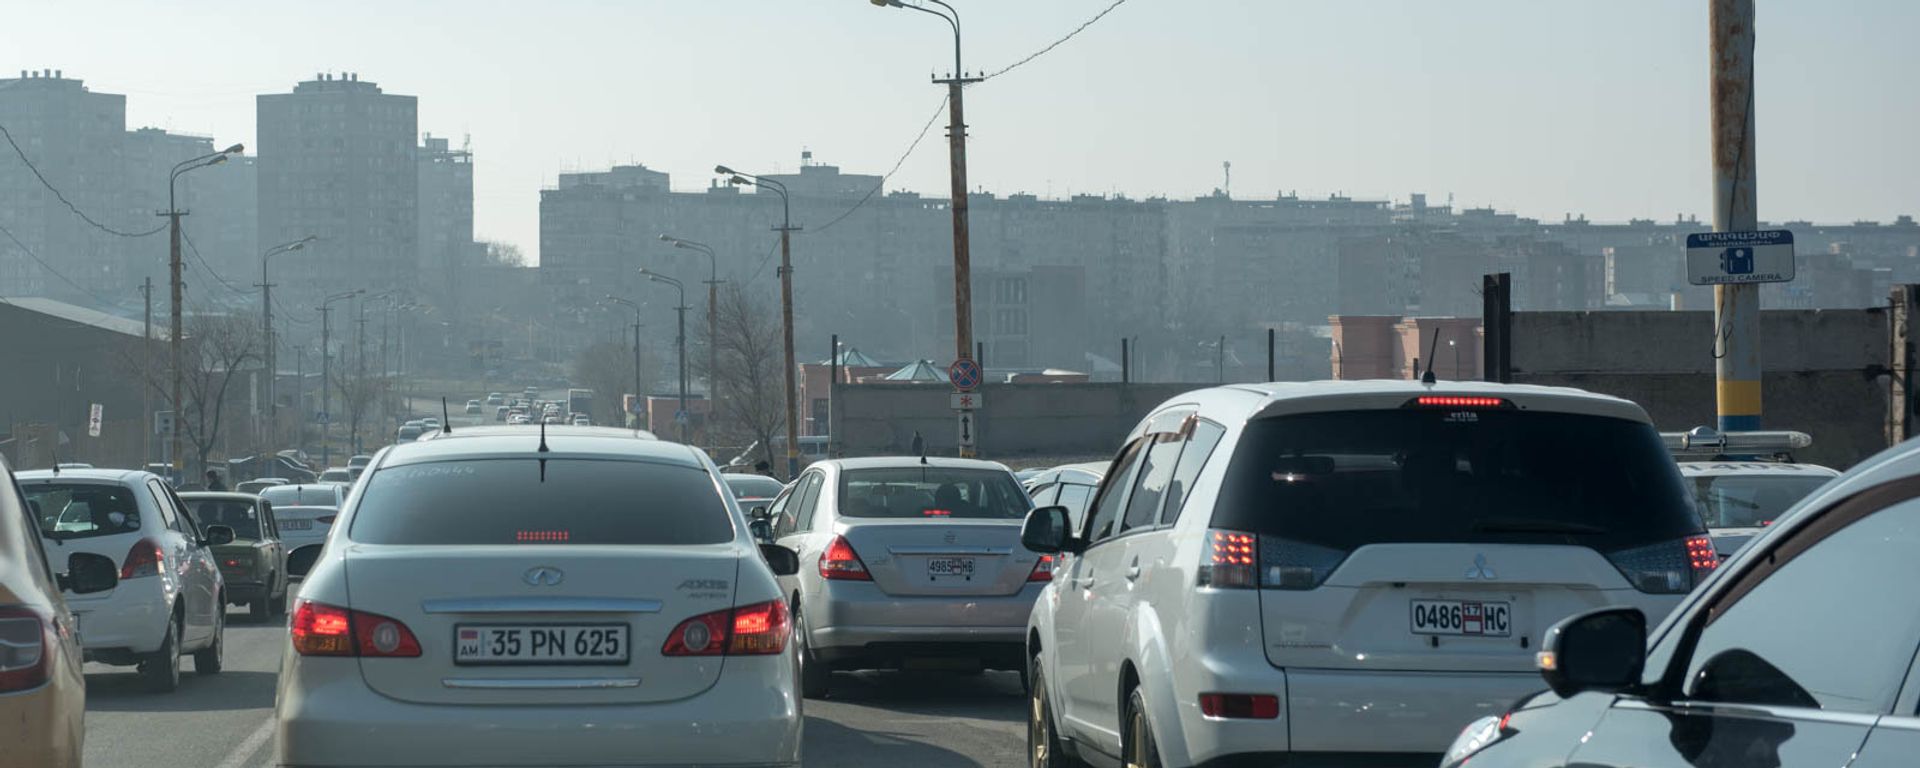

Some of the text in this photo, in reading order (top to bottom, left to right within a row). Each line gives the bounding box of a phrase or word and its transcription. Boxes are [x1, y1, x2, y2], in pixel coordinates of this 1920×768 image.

[1701, 273, 1782, 283] SPEED CAMERA
[930, 560, 952, 572] 4985
[1415, 604, 1462, 629] 0486
[1484, 606, 1507, 630] HC
[492, 630, 619, 656] 35 PN 625
[460, 645, 478, 656] AM
